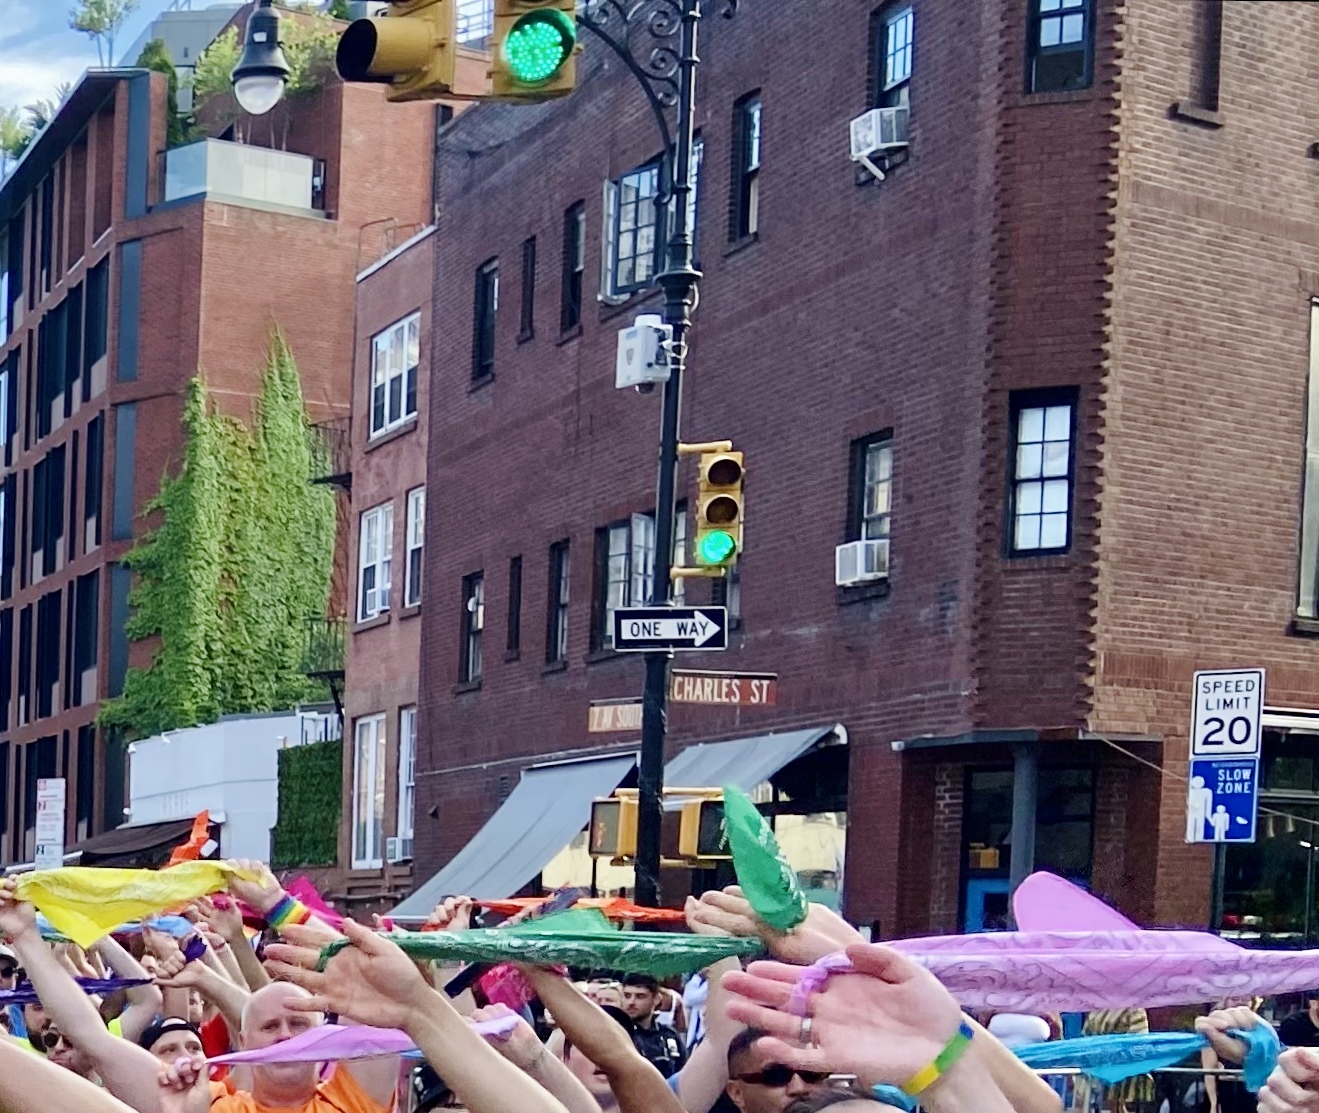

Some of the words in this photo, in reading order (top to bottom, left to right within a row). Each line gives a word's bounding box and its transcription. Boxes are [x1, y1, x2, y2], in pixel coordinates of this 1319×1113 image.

[630, 621, 661, 637] ONE
[676, 621, 709, 637] WAY
[673, 676, 741, 703] CHARLES
[750, 680, 770, 704] ST
[1202, 679, 1256, 694] SPEED
[1205, 696, 1251, 711] LIMIT
[1202, 716, 1251, 746] 20
[1217, 768, 1252, 782] SLOW
[1216, 781, 1252, 795] ZONE
